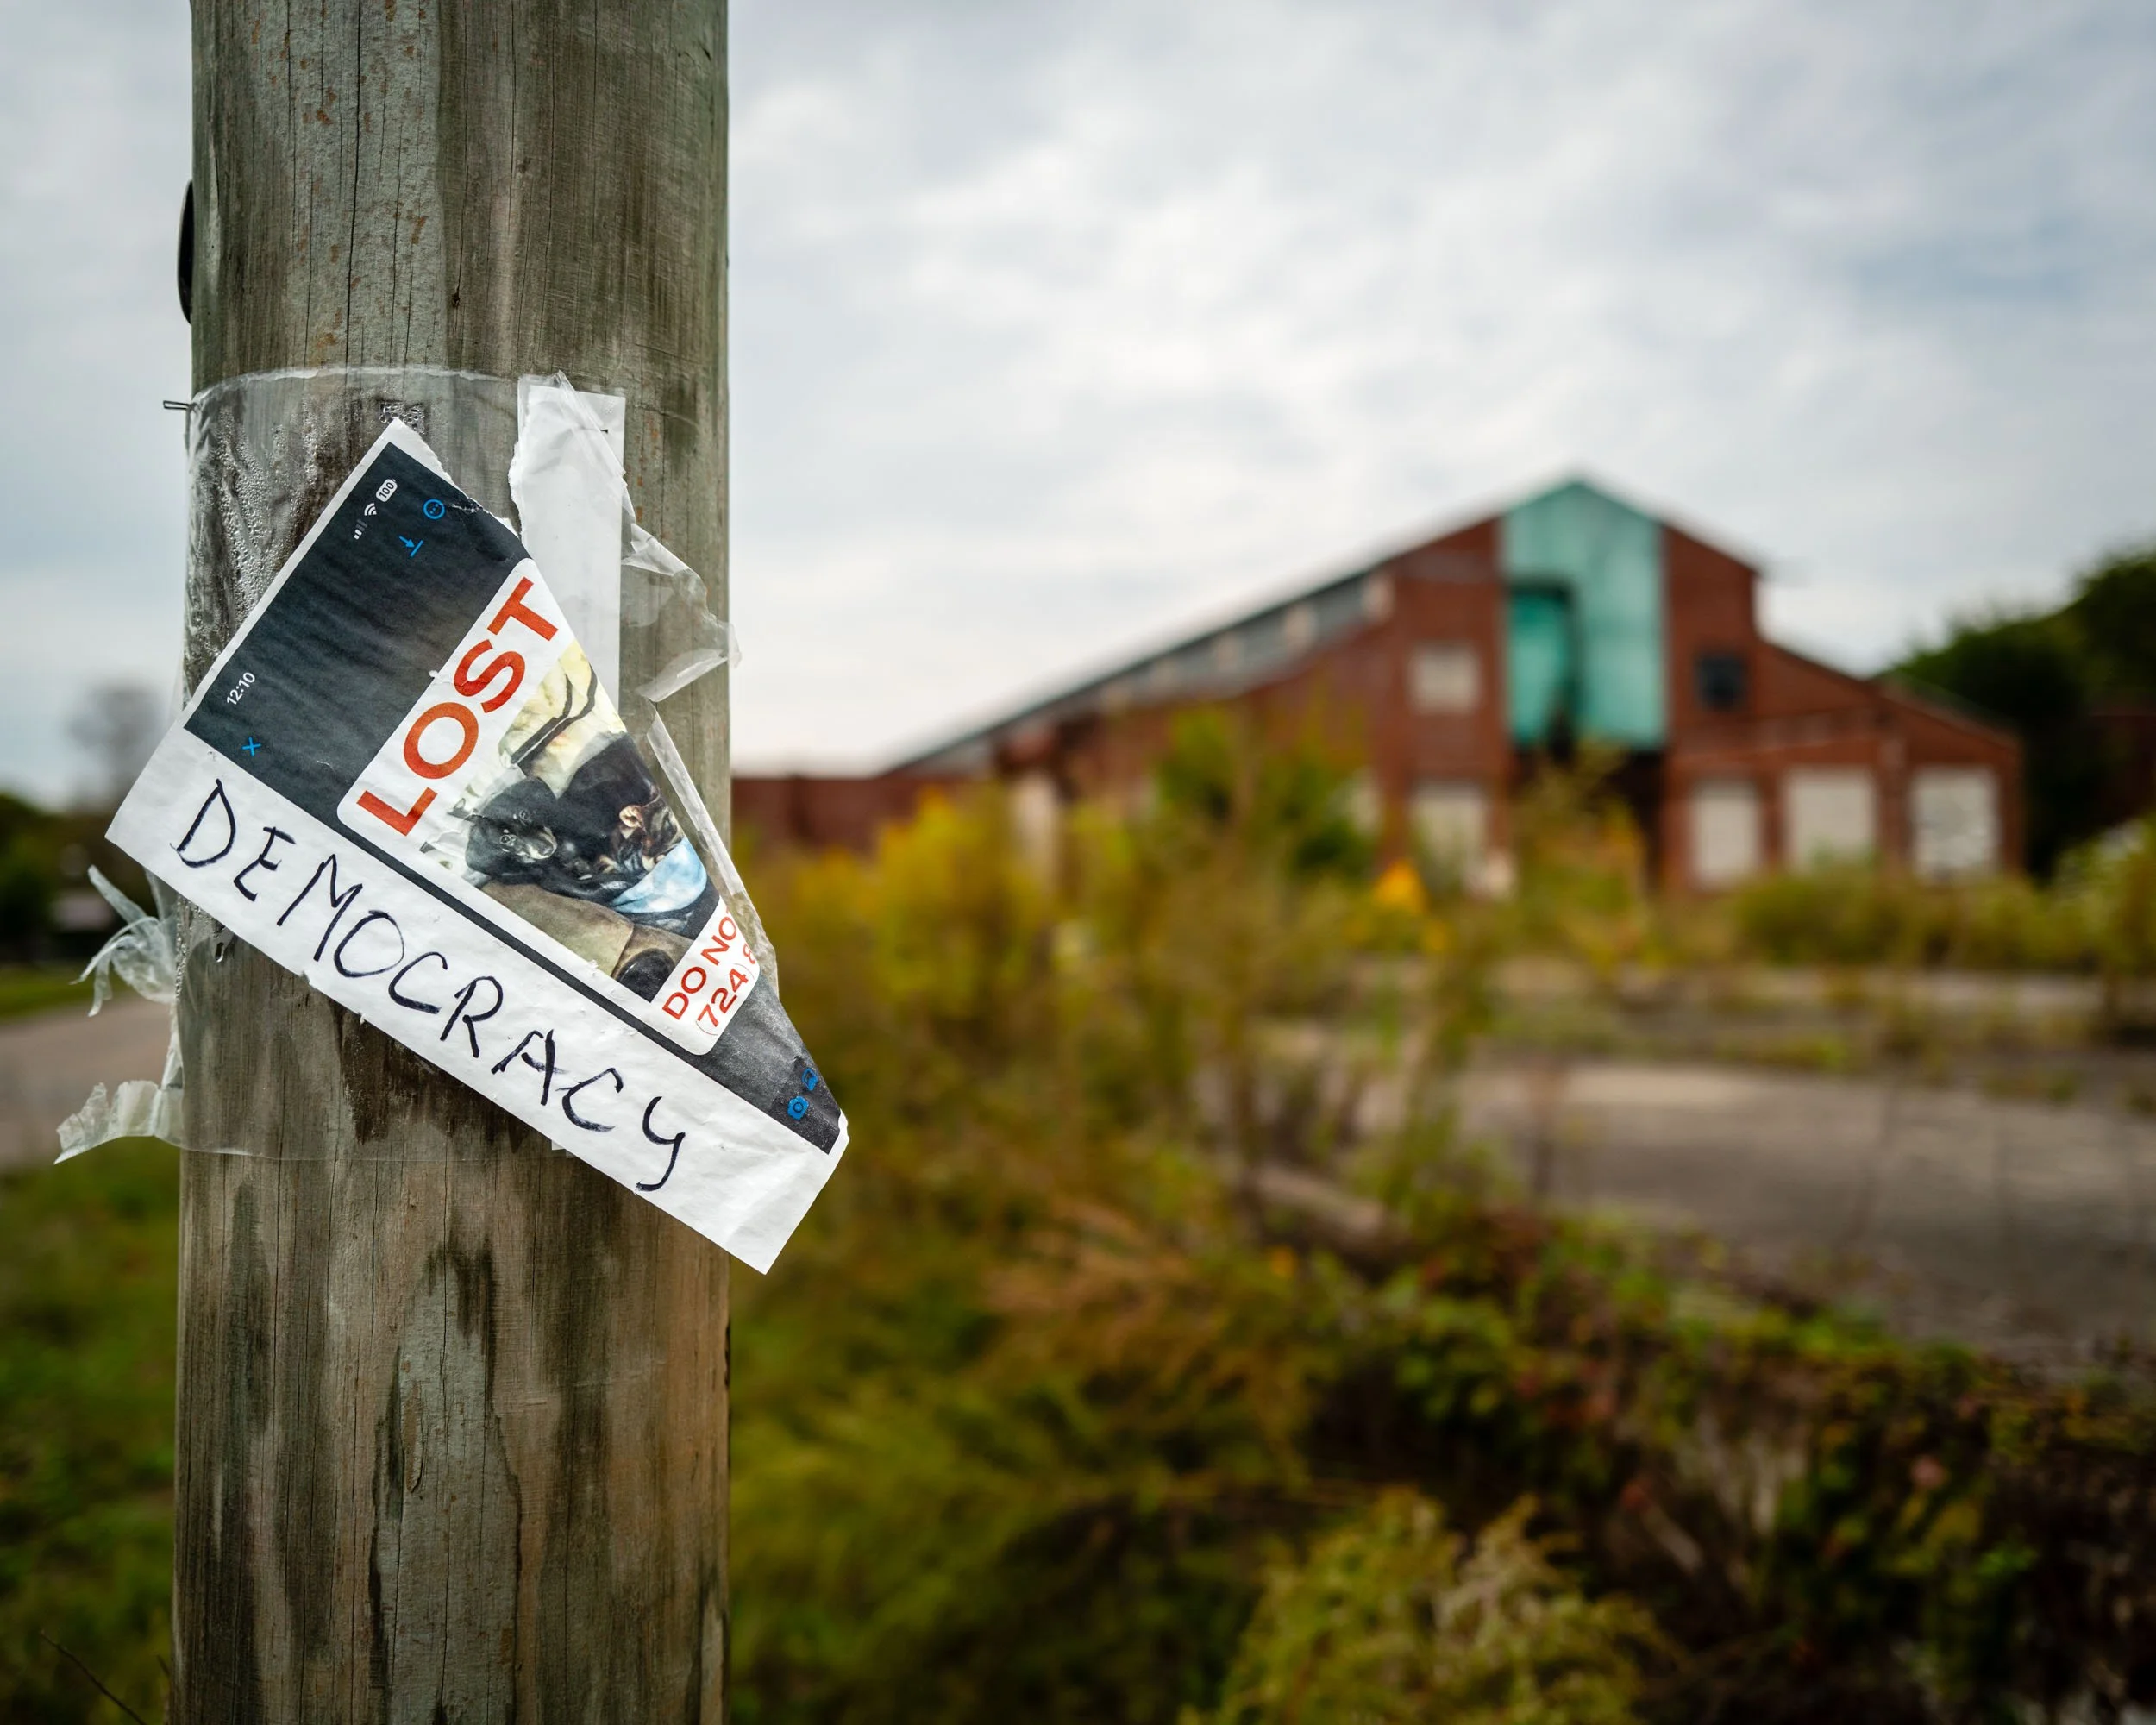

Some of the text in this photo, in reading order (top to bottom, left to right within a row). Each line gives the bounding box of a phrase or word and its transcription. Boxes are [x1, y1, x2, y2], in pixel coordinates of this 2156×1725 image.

[226, 481, 394, 705] 12:10 100
[356, 576, 558, 837] LOST
[170, 778, 686, 1191] DEMOCRACY
[661, 906, 737, 1020] DO NO
[696, 963, 755, 1035] (724)
